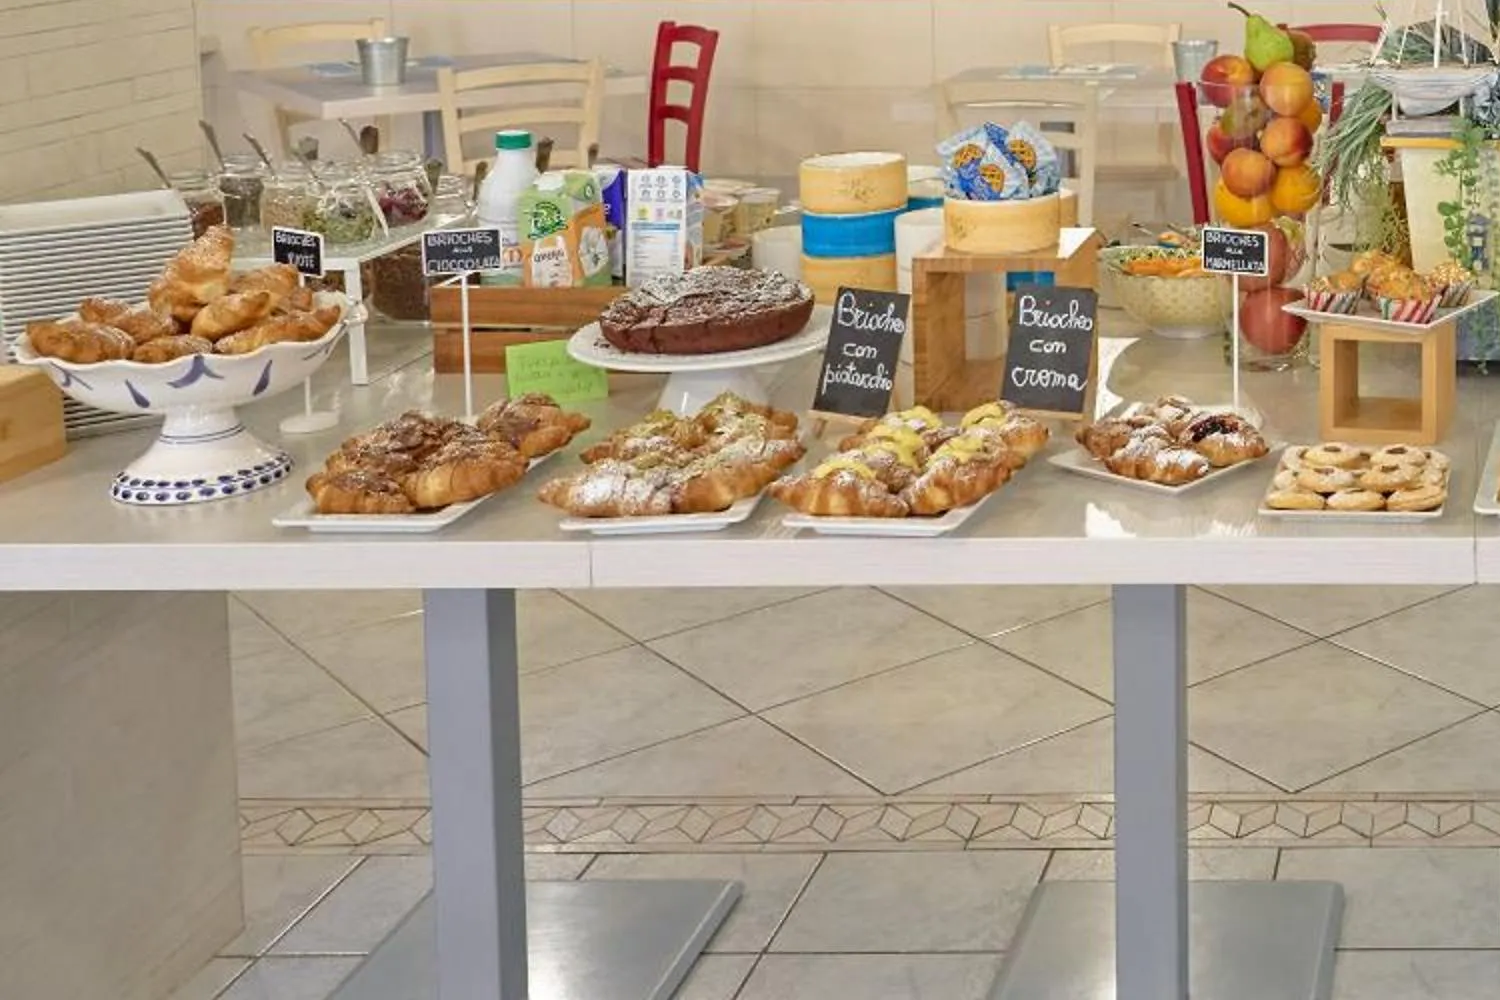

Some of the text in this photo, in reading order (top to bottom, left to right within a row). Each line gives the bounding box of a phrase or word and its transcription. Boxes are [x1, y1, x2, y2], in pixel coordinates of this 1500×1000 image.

[427, 231, 493, 247] BRIOCHES
[1206, 231, 1259, 247] BRIOCHES
[1019, 295, 1093, 331] Brioches
